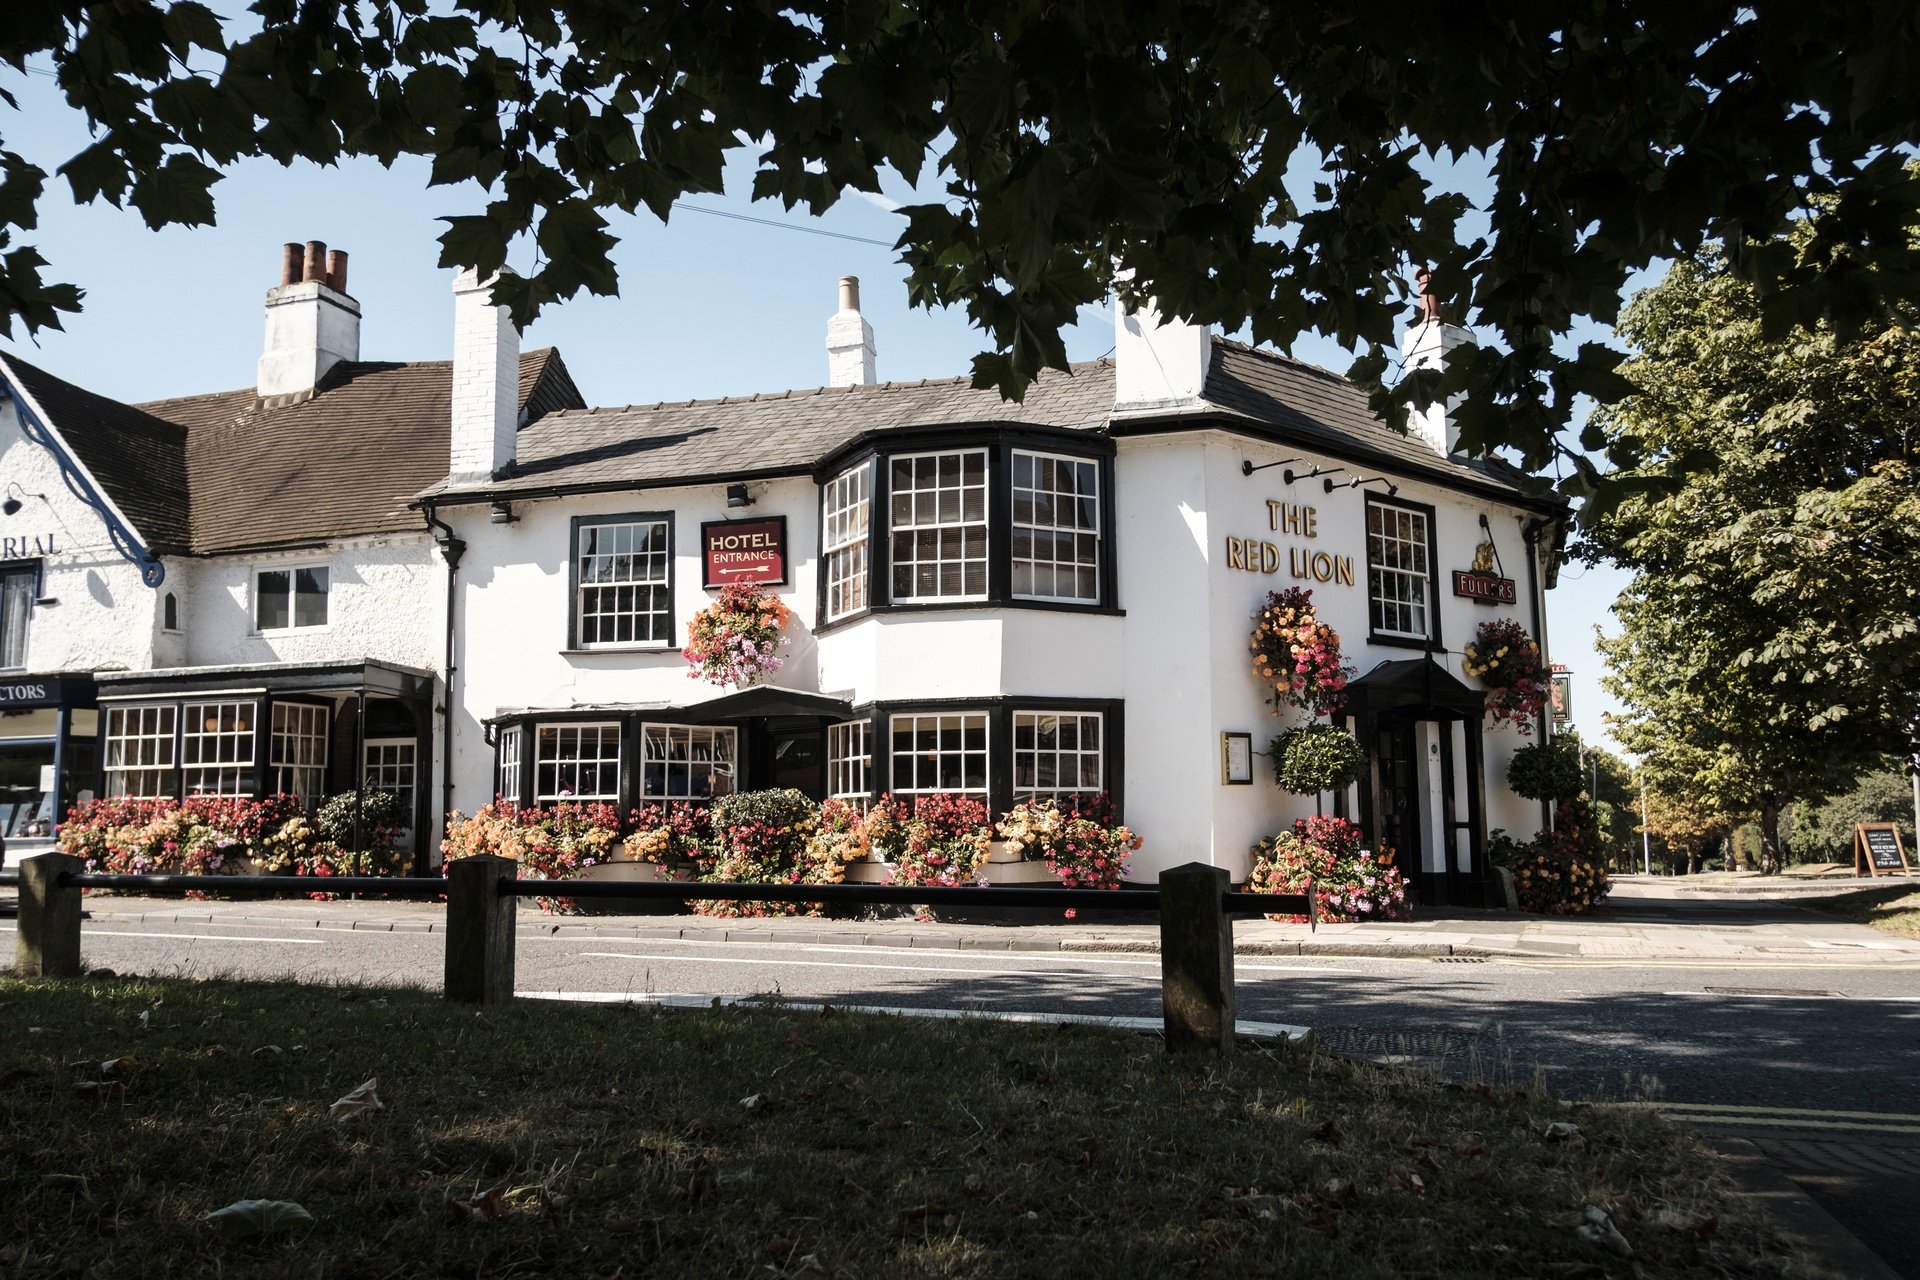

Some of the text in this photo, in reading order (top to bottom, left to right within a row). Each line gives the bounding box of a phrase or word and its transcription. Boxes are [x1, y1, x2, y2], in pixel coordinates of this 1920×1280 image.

[1266, 499, 1318, 539] THE
[3, 533, 63, 559] RIAL
[710, 532, 778, 551] HOTEL
[713, 550, 775, 564] ENTRANCE
[1226, 536, 1355, 587] RED LION
